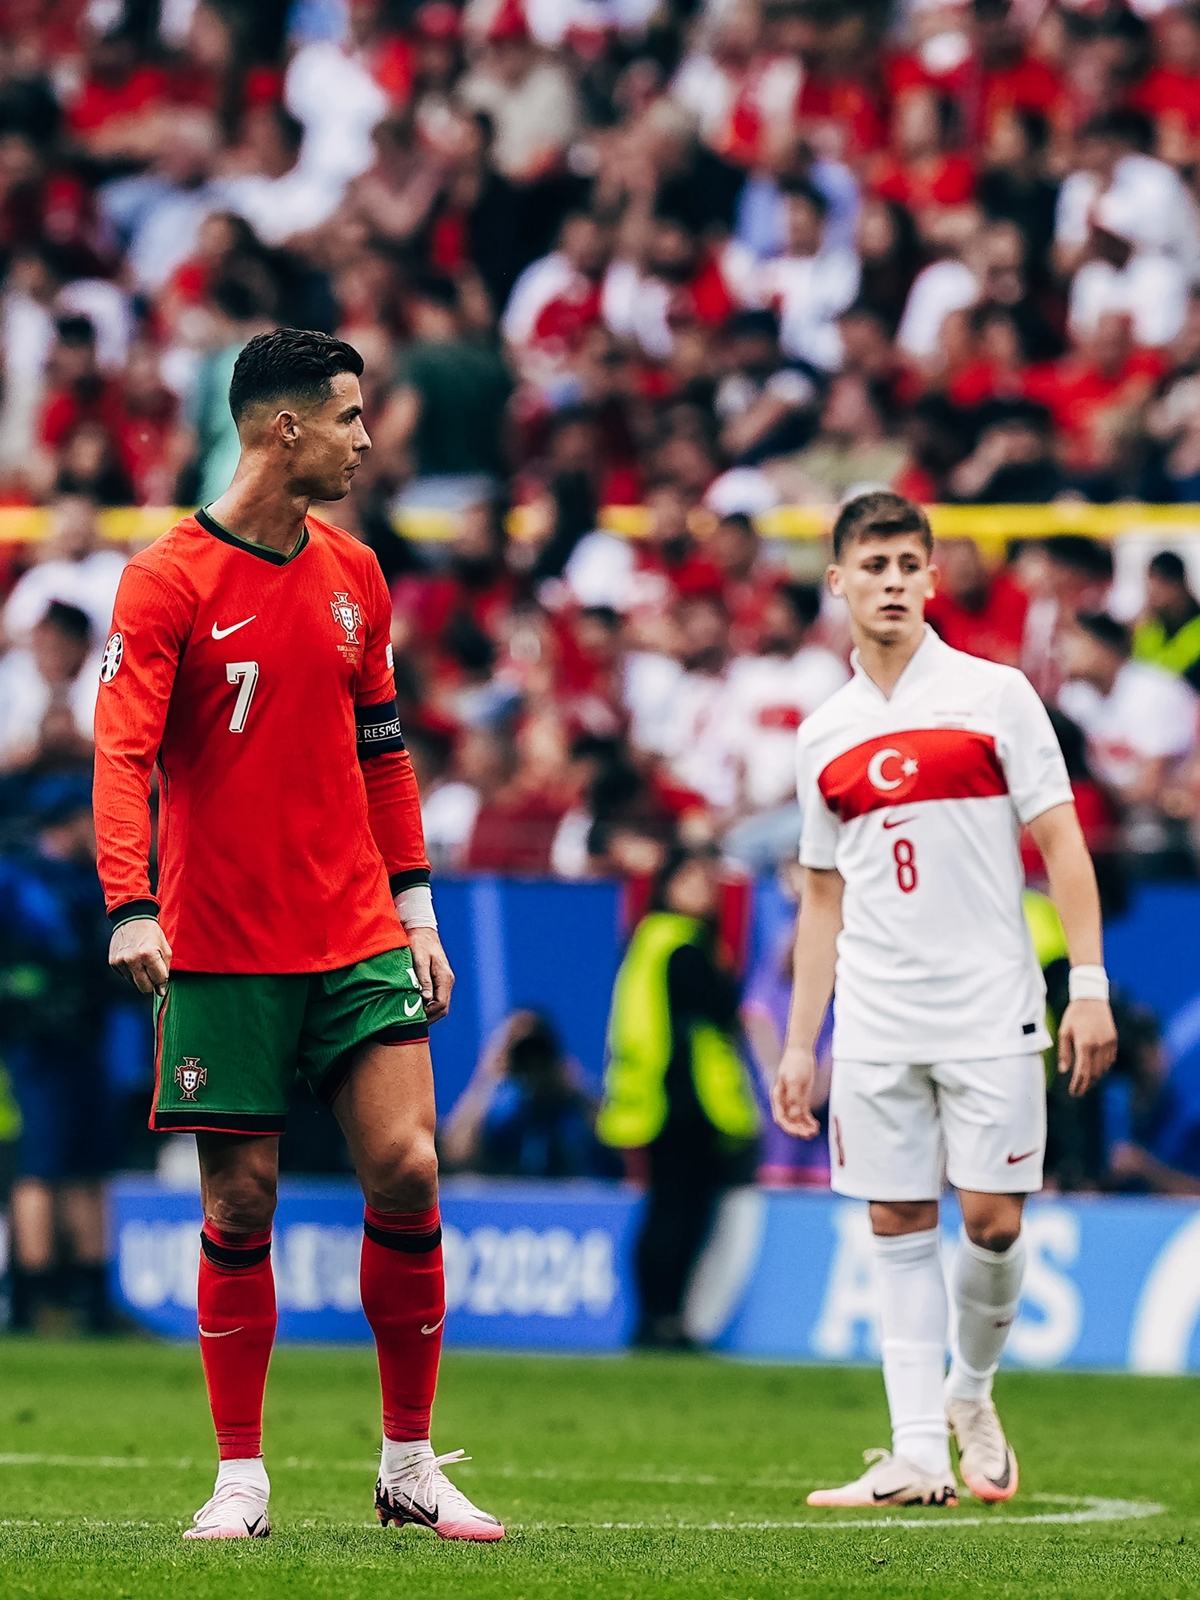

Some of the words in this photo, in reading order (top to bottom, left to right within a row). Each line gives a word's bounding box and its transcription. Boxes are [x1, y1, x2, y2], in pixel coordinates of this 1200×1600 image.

[225, 661, 259, 732] 7
[363, 721, 400, 739] RESPEC
[892, 838, 918, 893] 8
